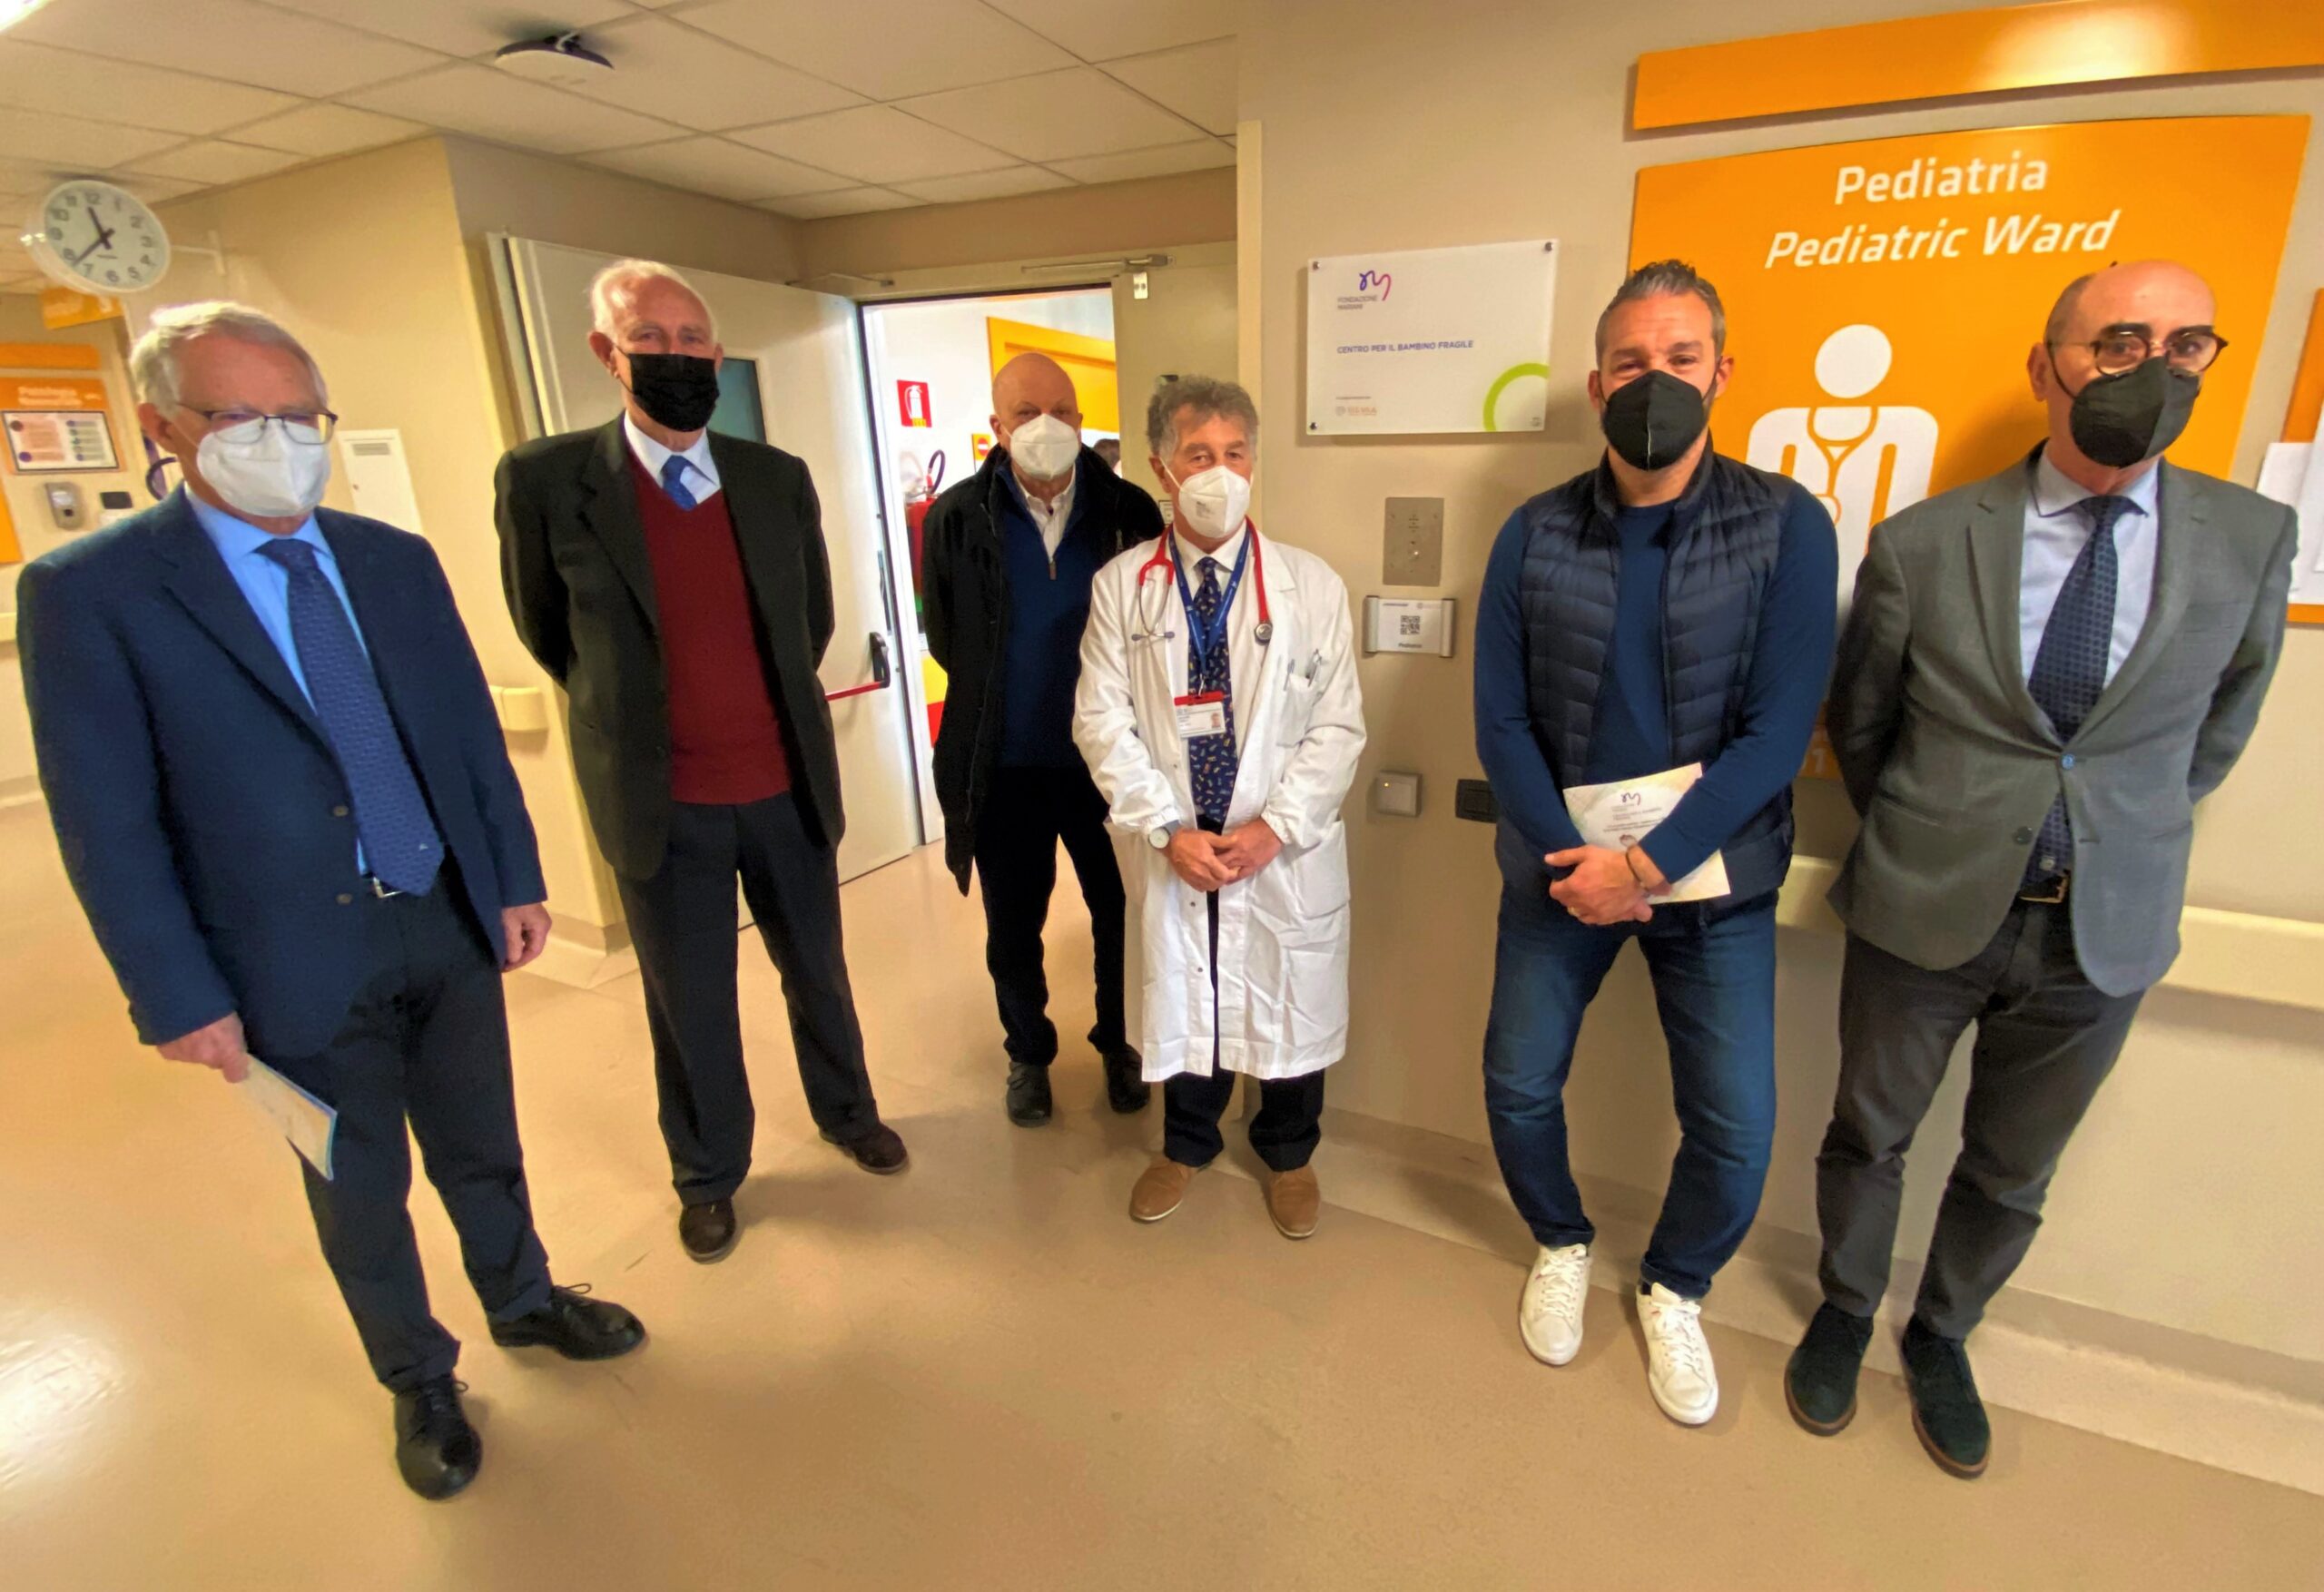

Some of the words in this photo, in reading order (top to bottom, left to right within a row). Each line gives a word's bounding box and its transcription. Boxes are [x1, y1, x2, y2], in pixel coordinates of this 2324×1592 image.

[1835, 150, 2048, 205] Pediatria
[84, 192, 101, 205] 12
[1764, 218, 1968, 269] Pediatric
[1983, 209, 2122, 256] Ward
[1337, 345, 1369, 354] CENTRO
[1371, 344, 1386, 352] PER
[1389, 343, 1395, 351] IL
[1398, 341, 1436, 351] BAMBINO
[1438, 339, 1474, 349] FRAGILE
